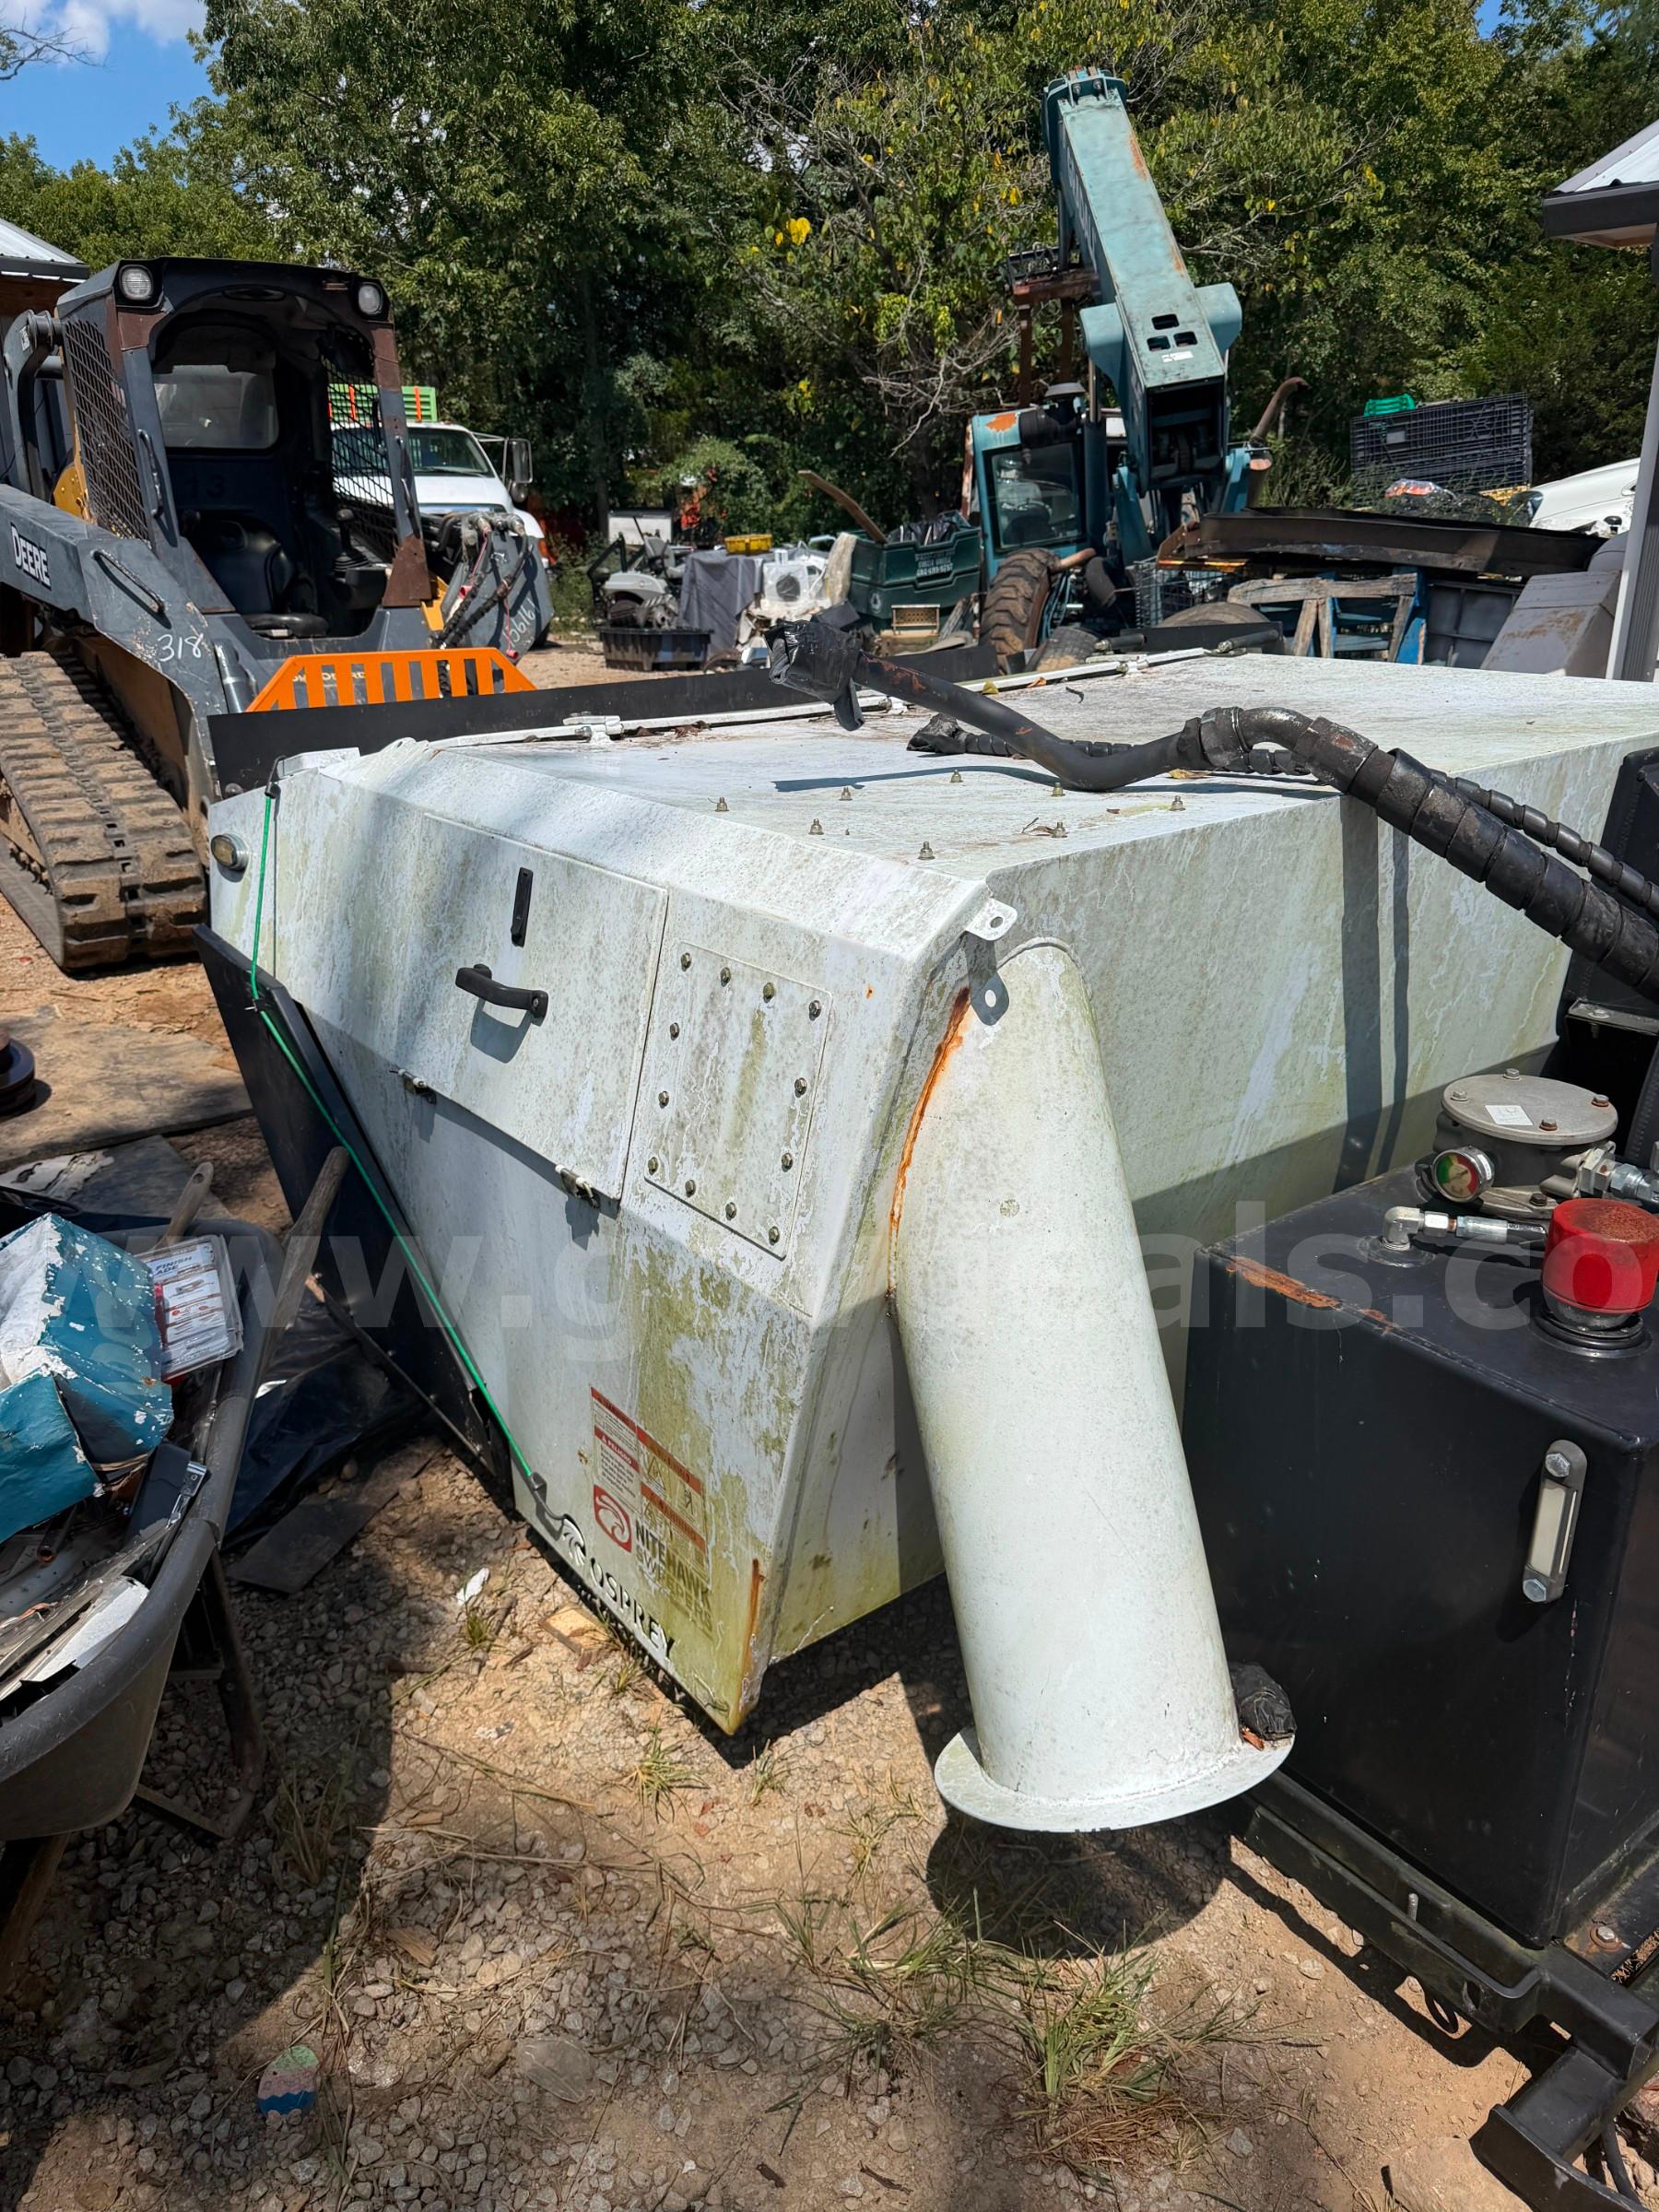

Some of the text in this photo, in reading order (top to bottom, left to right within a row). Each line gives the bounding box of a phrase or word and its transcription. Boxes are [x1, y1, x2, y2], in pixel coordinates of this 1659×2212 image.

[11, 524, 51, 586] DEERE
[158, 633, 204, 661] 318
[590, 1557, 676, 1658] OSPREY
